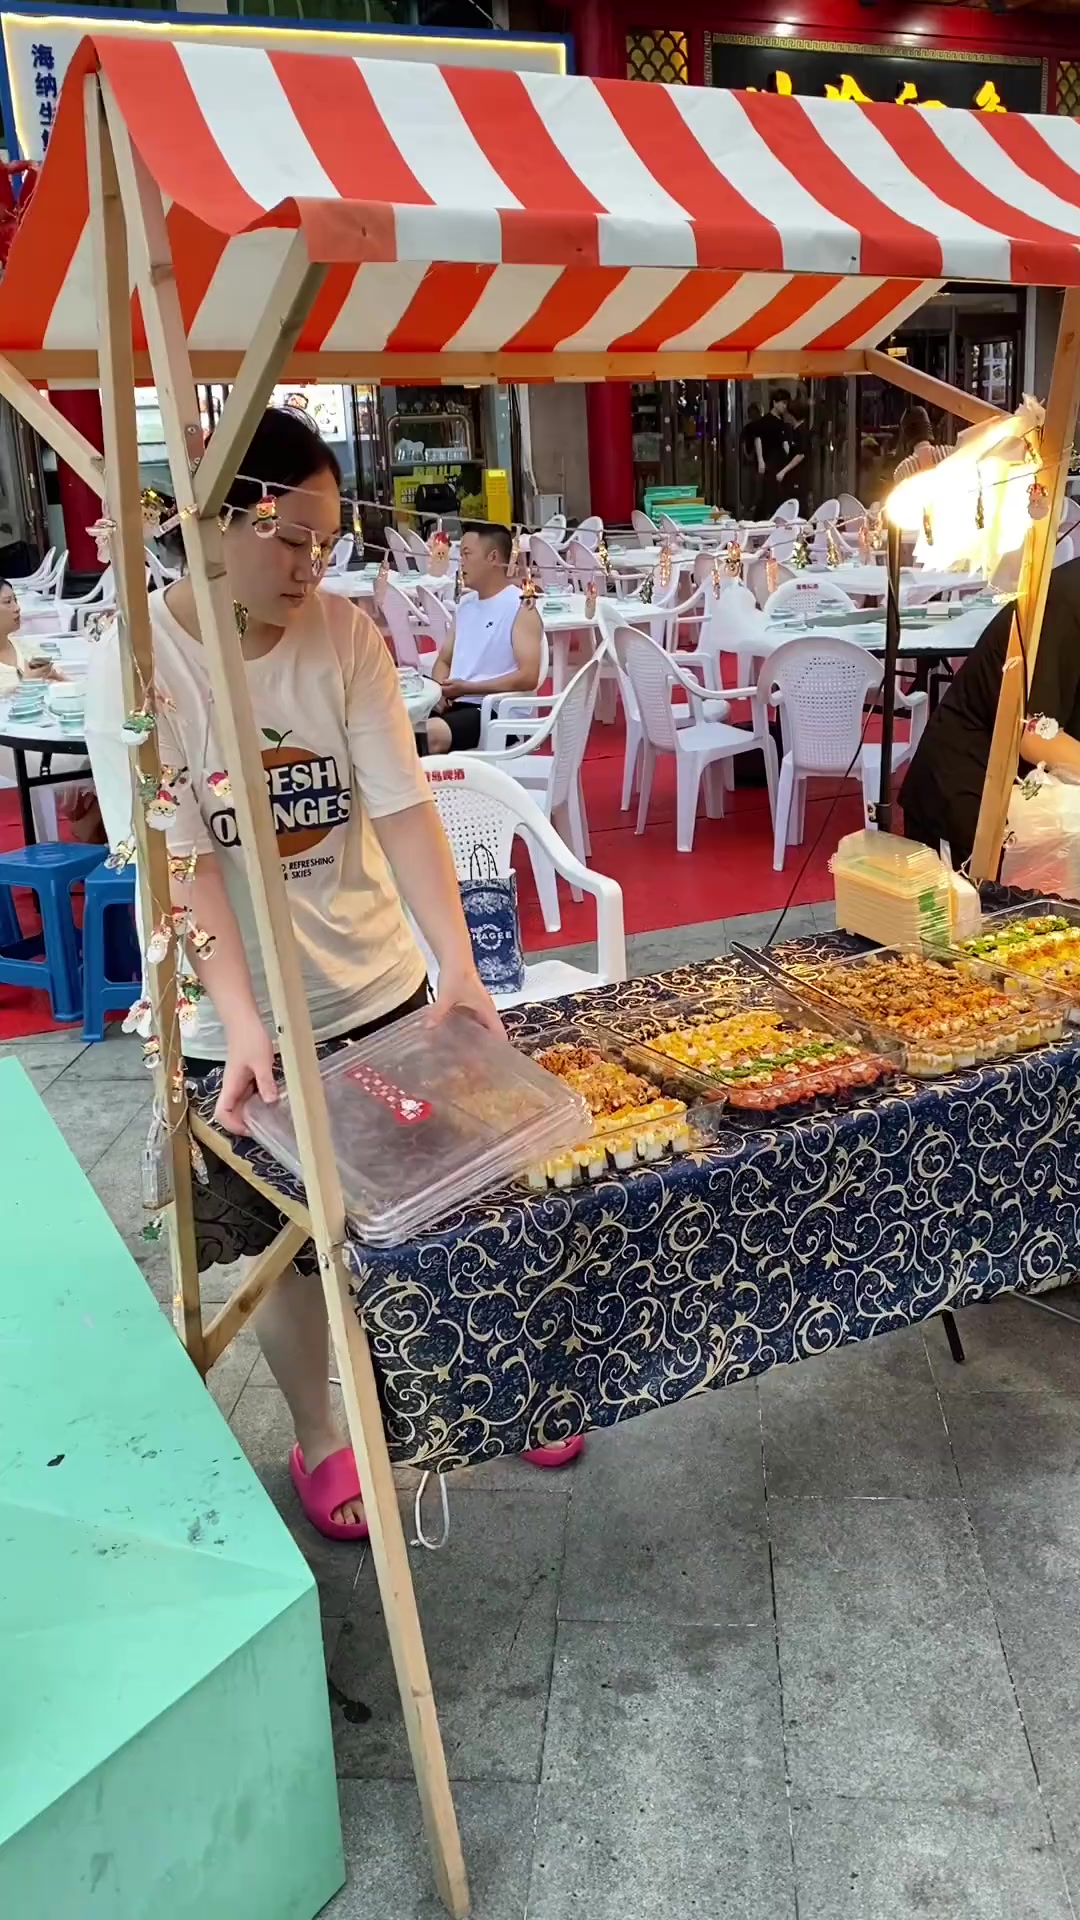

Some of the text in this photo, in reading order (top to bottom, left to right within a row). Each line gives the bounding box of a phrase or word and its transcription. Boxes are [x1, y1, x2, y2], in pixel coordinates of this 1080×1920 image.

[31, 43, 57, 152] 海纳生
[264, 759, 337, 796] ESH
[211, 790, 351, 844] ONGES
[289, 856, 334, 870] REFRESHING
[291, 869, 312, 880] SKIES
[472, 930, 512, 941] HAGEE
